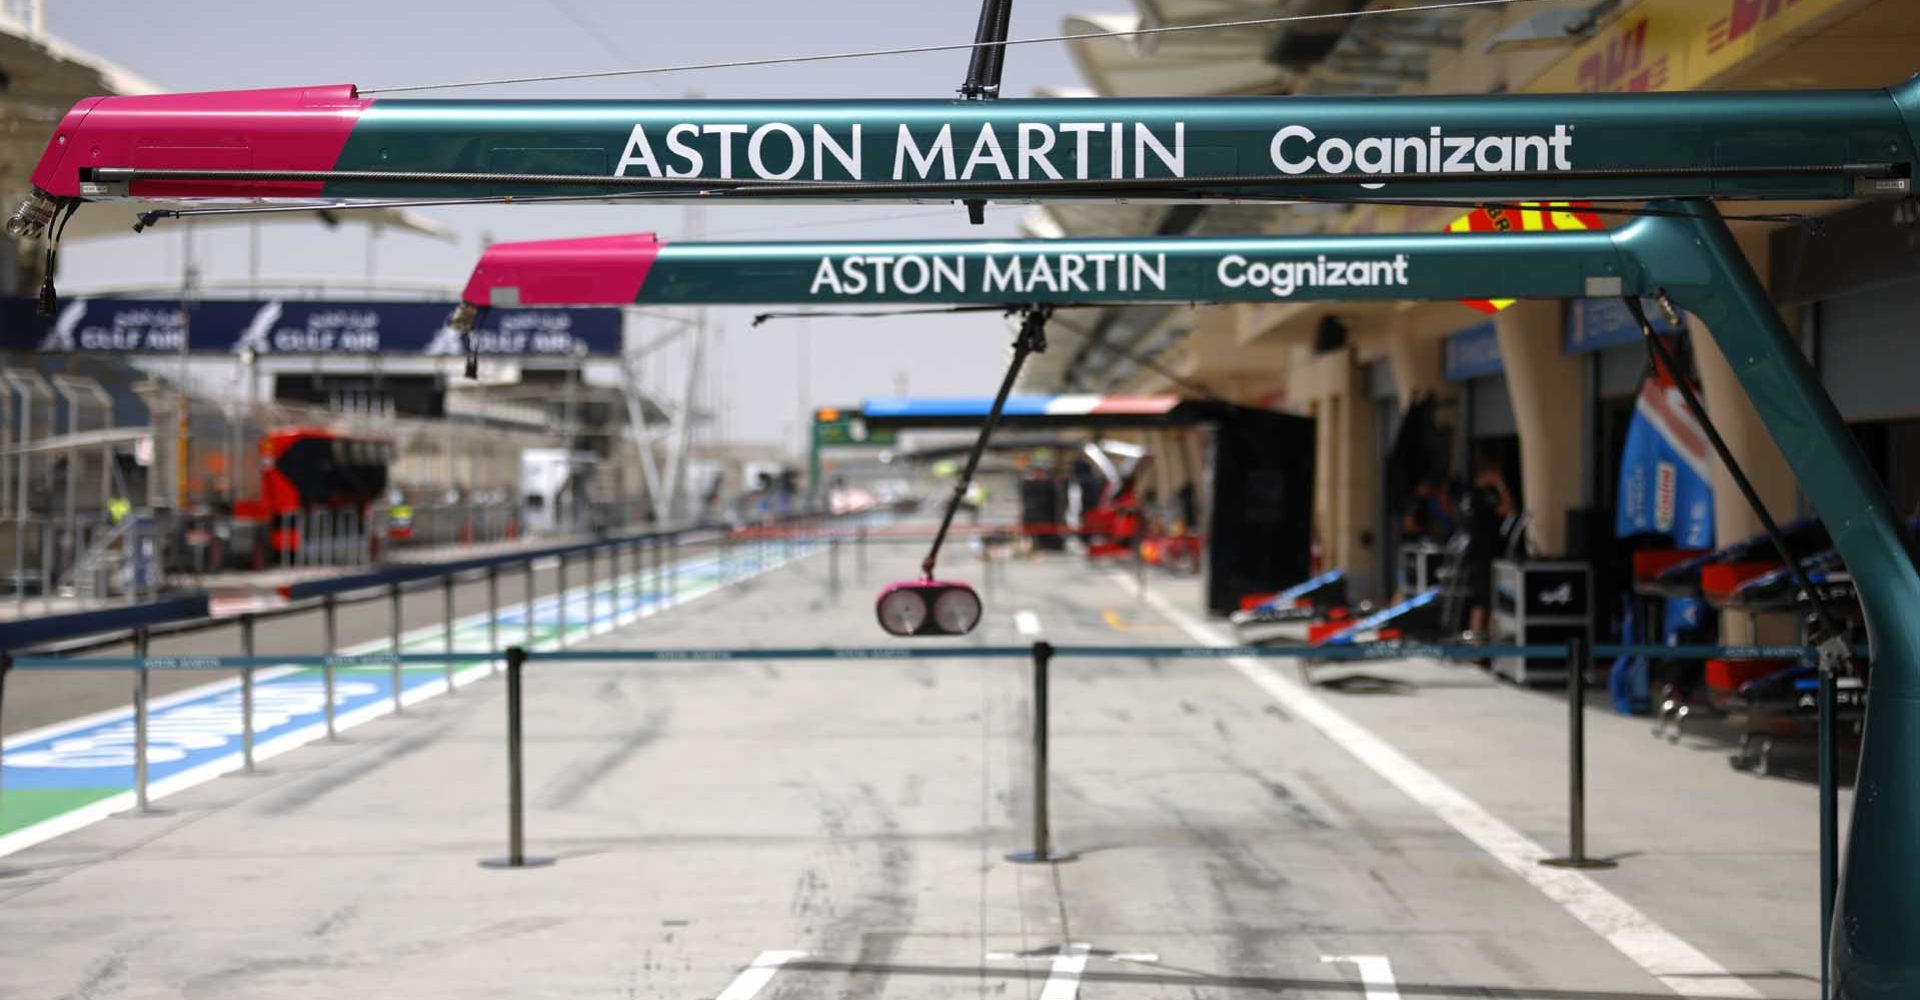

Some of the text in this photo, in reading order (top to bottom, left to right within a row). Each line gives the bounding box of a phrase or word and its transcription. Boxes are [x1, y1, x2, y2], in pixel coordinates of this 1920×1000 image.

[613, 121, 1185, 181] ASTON MARTIN
[1269, 124, 1573, 189] Cognizant
[809, 253, 1166, 295] ASTON MARTIN
[1217, 253, 1409, 297] Cognizant
